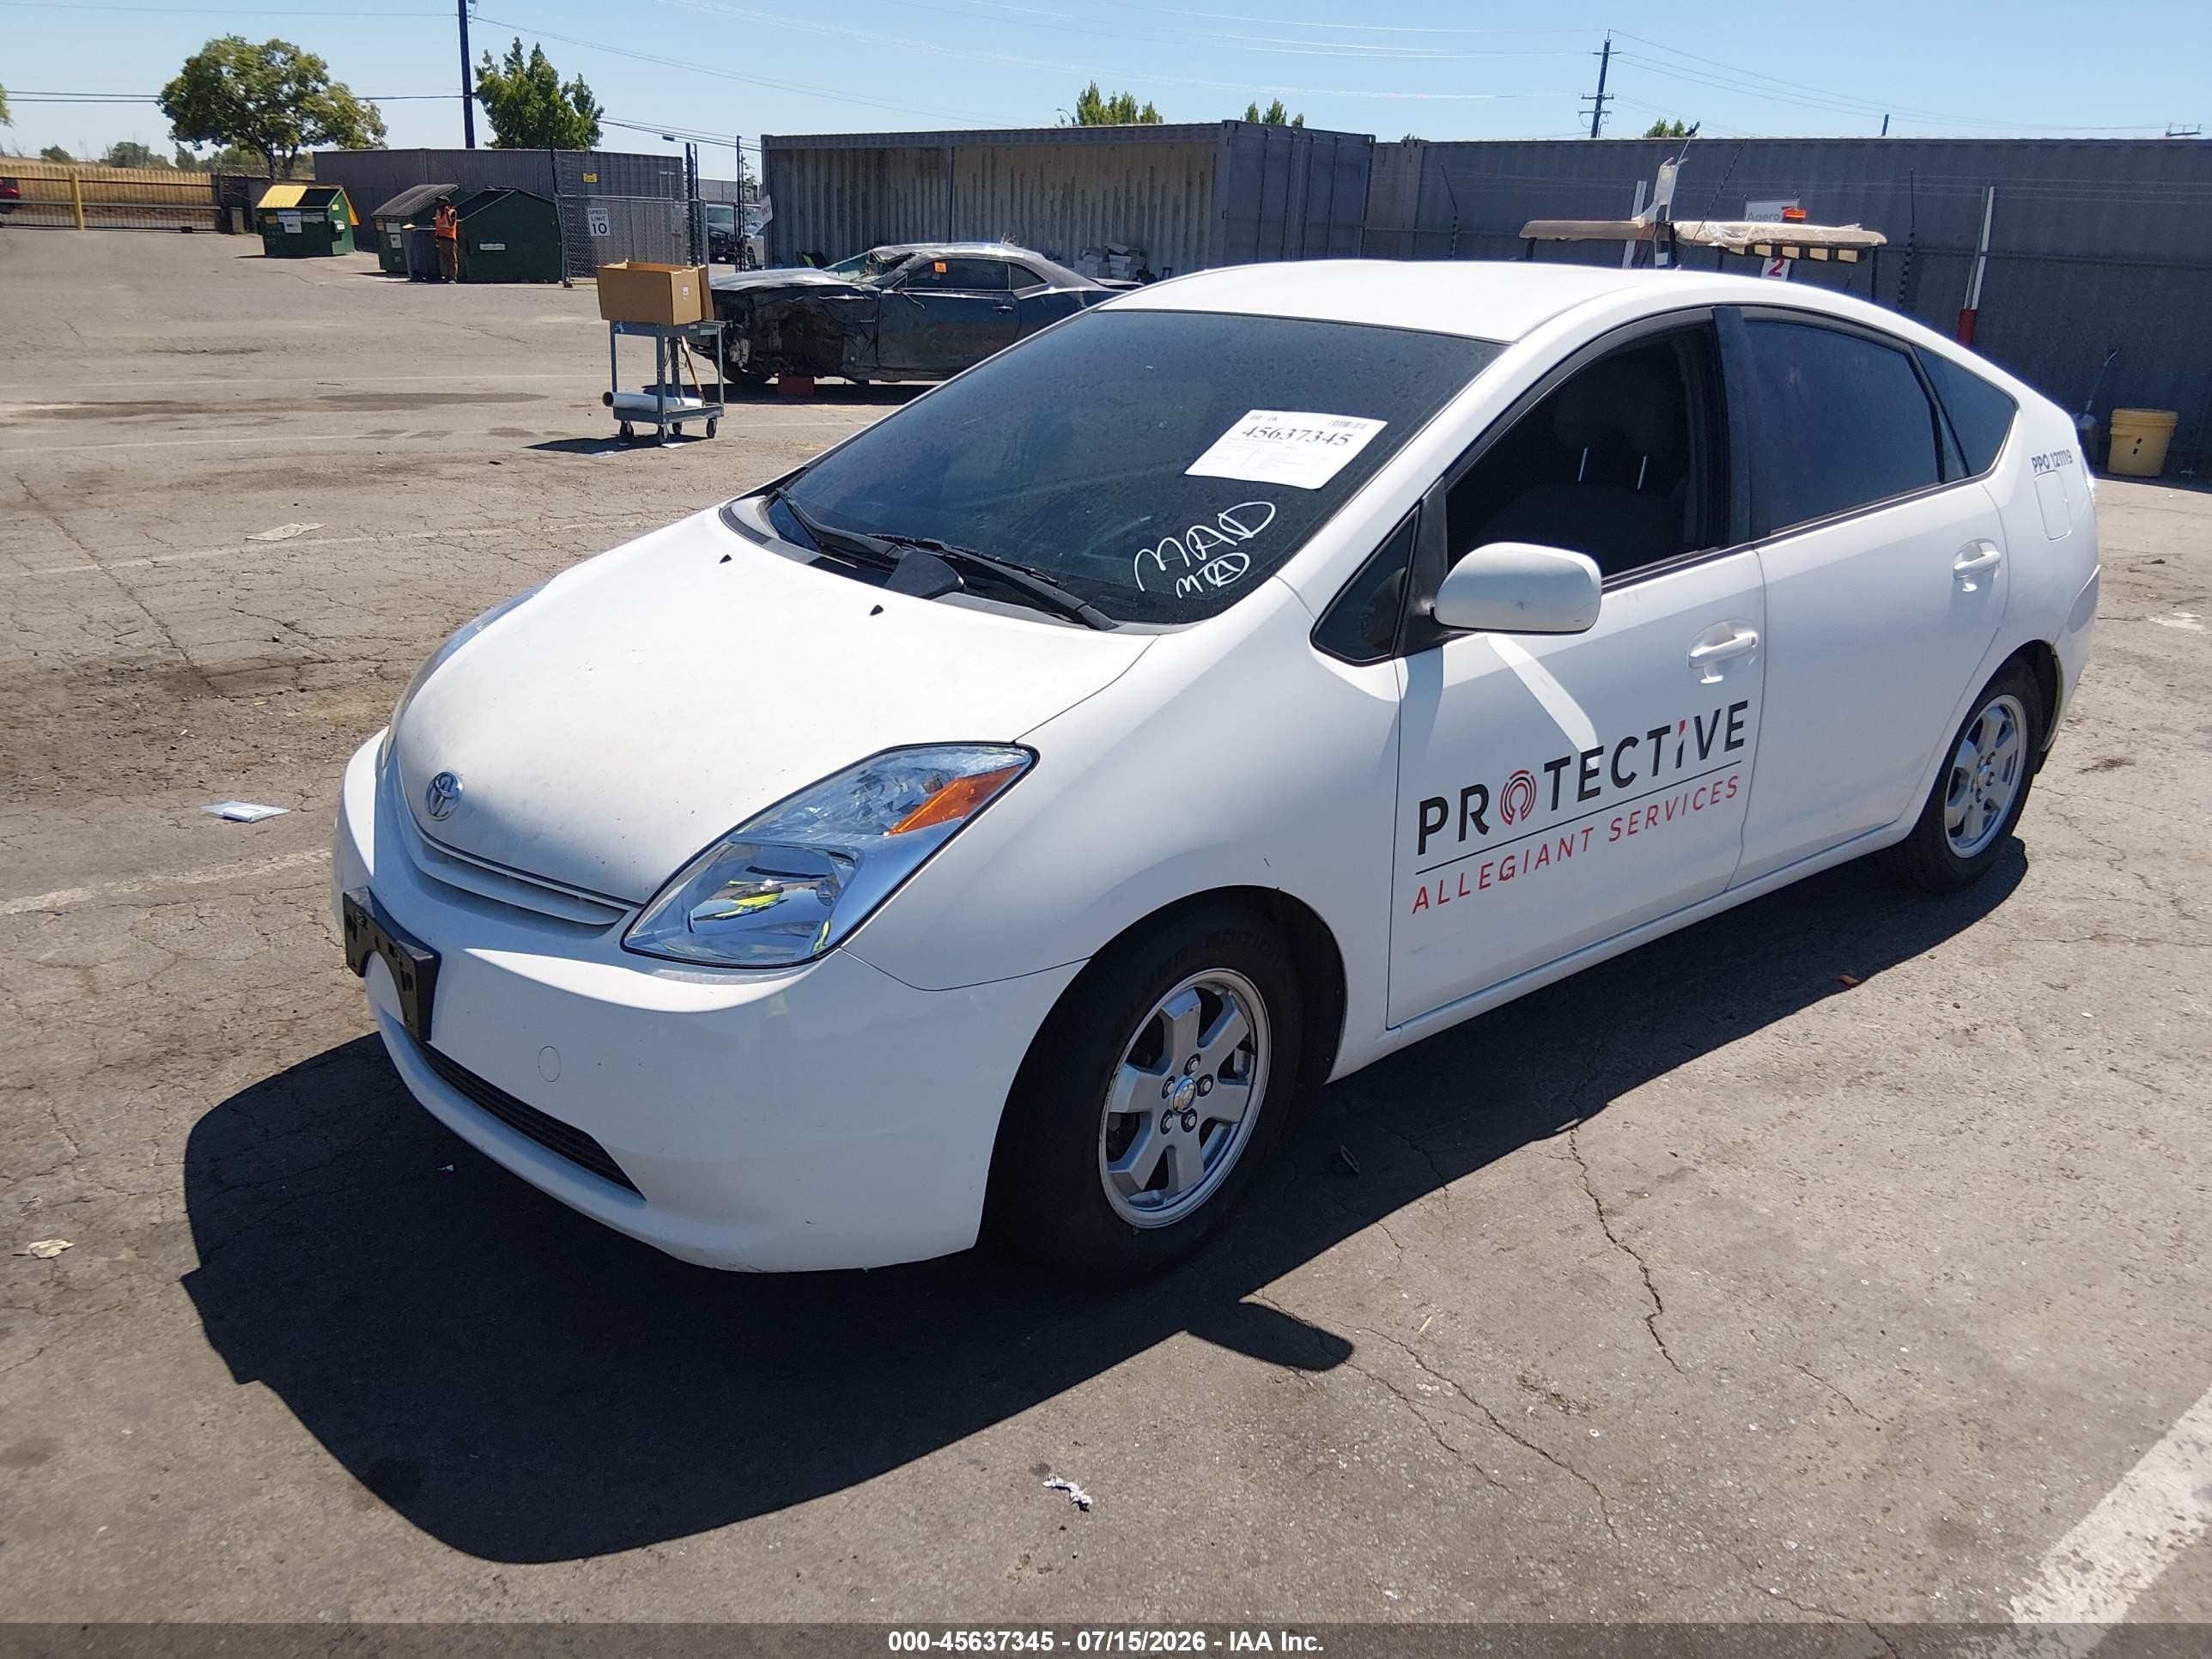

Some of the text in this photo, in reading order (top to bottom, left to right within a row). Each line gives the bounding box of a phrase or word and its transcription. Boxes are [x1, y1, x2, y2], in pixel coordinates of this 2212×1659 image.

[592, 222, 607, 234] 10
[1767, 258, 1786, 277] 2
[1242, 425, 1354, 447] 45637345
[1417, 699, 1749, 857] PROTECTIVE
[1412, 775, 1740, 915] ALLEGIANT SERVICES
